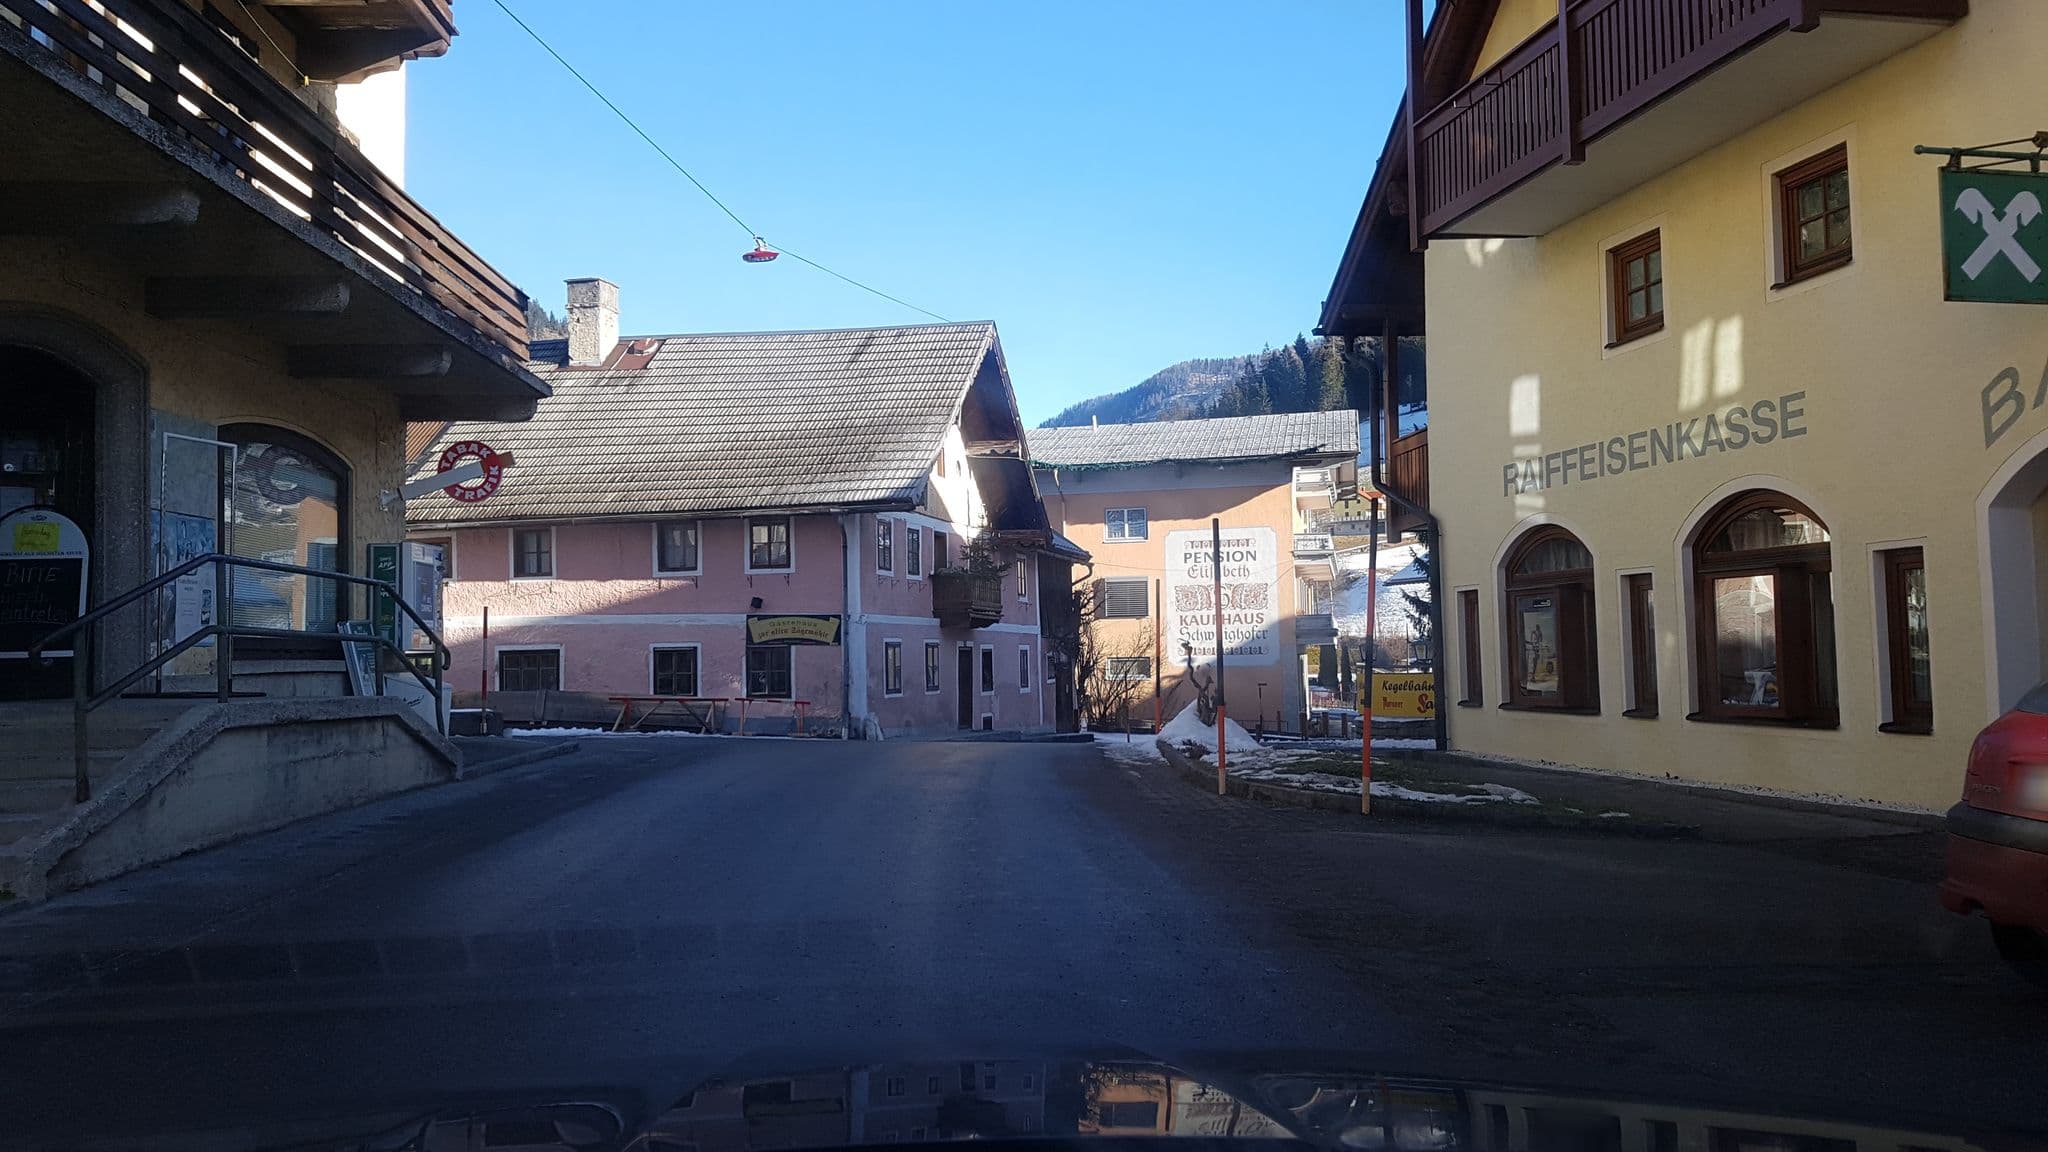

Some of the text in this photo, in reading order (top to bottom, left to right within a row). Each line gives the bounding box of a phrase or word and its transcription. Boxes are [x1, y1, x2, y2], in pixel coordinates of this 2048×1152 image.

[1982, 355, 2048, 449] B
[1504, 390, 1807, 497] RAIFFEISENKASSE
[441, 444, 490, 469] TABAK
[456, 467, 499, 501] TRAFIK
[1184, 550, 1257, 563] PENSION
[1187, 564, 1250, 580] Elisbeth
[1179, 625, 1269, 643] Schwighofer
